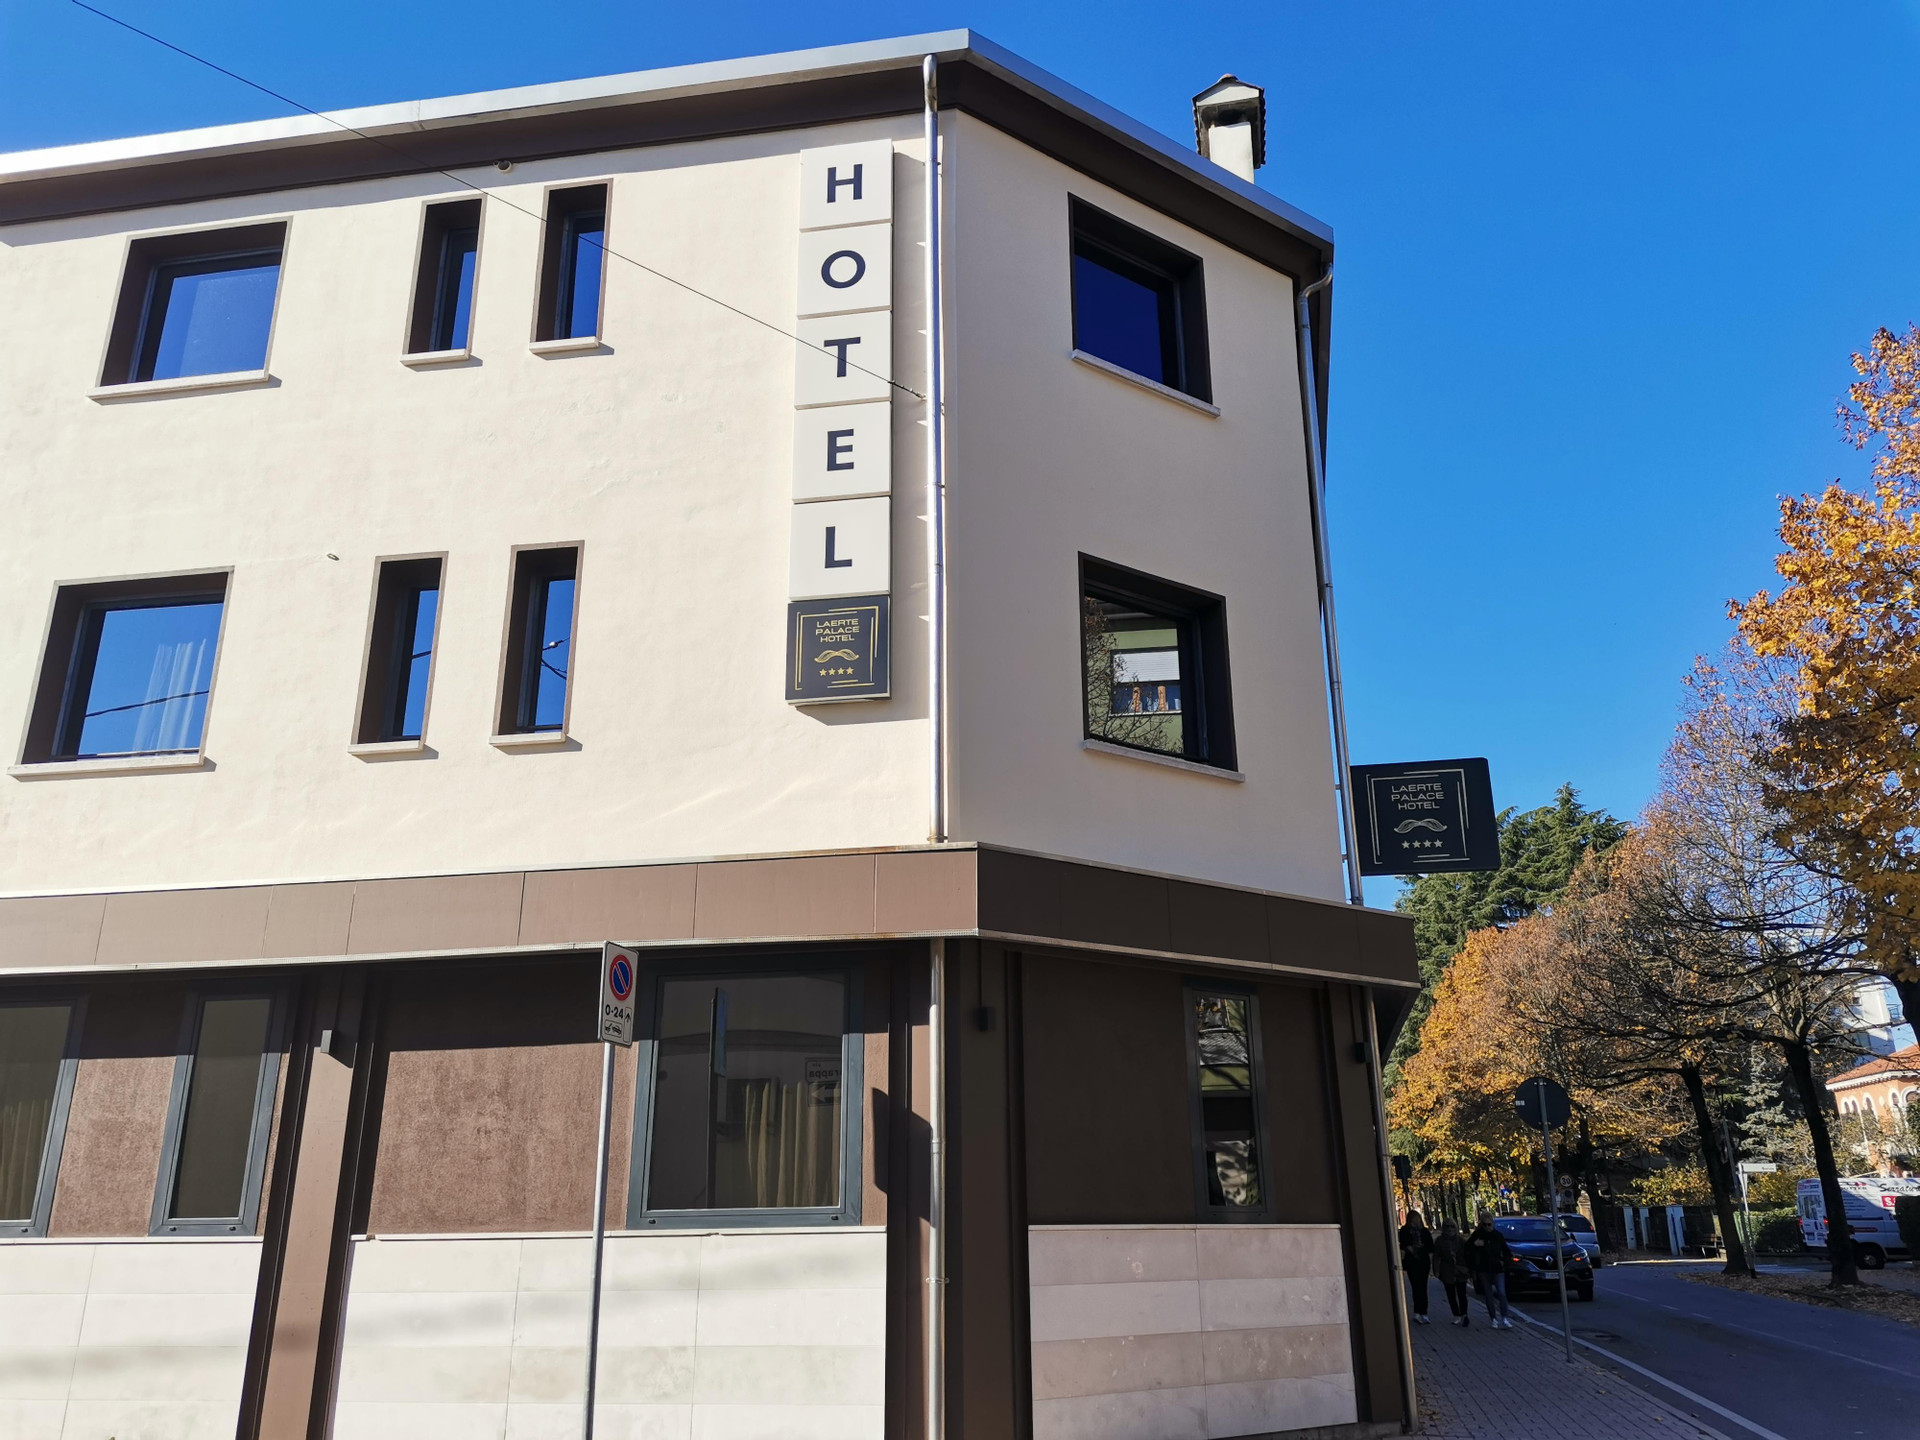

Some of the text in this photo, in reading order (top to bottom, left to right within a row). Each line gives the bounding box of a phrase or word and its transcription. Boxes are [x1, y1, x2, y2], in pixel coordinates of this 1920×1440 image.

[821, 163, 866, 568] HOTEL
[816, 618, 859, 628] LAERTE
[815, 626, 860, 636] PALACE
[820, 634, 855, 643] HOTEL
[1391, 783, 1442, 793] LAERTE
[1391, 792, 1445, 802] PALACE
[1398, 801, 1440, 810] HOTEL
[1561, 1177, 1571, 1185] 30
